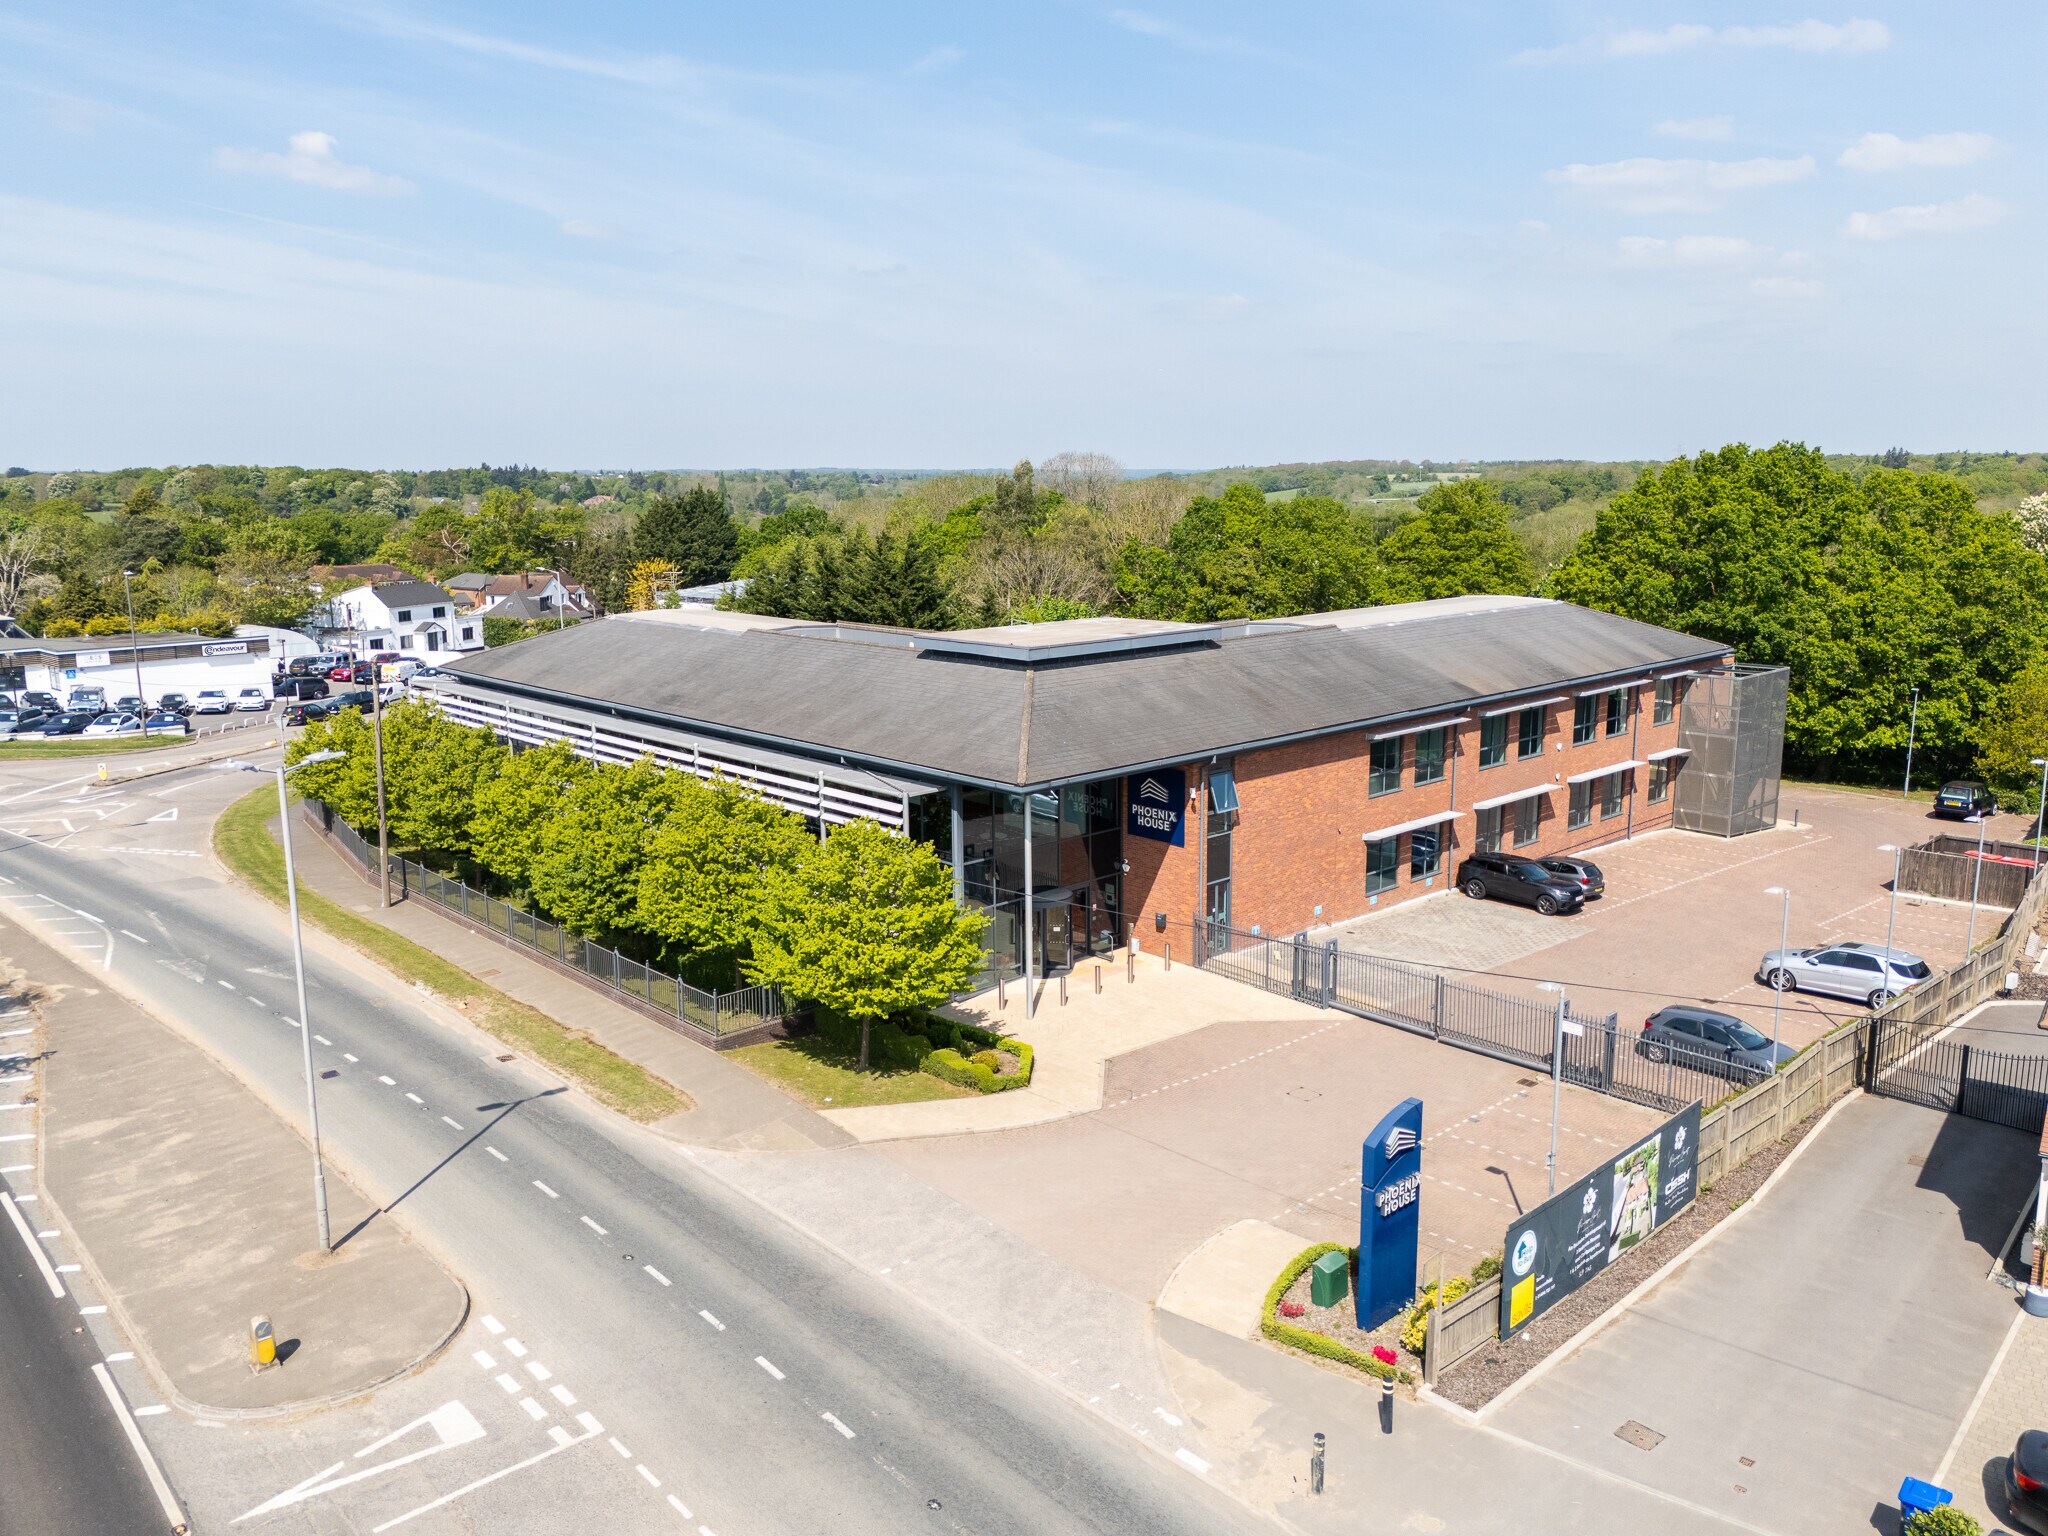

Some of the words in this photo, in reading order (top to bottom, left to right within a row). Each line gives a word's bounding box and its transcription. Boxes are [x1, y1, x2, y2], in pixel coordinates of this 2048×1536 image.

[1132, 804, 1177, 823] PHOENIX
[1137, 815, 1171, 832] HOUSE
[1377, 1173, 1421, 1207] PHOENIX
[1383, 1188, 1417, 1216] HOUSE
